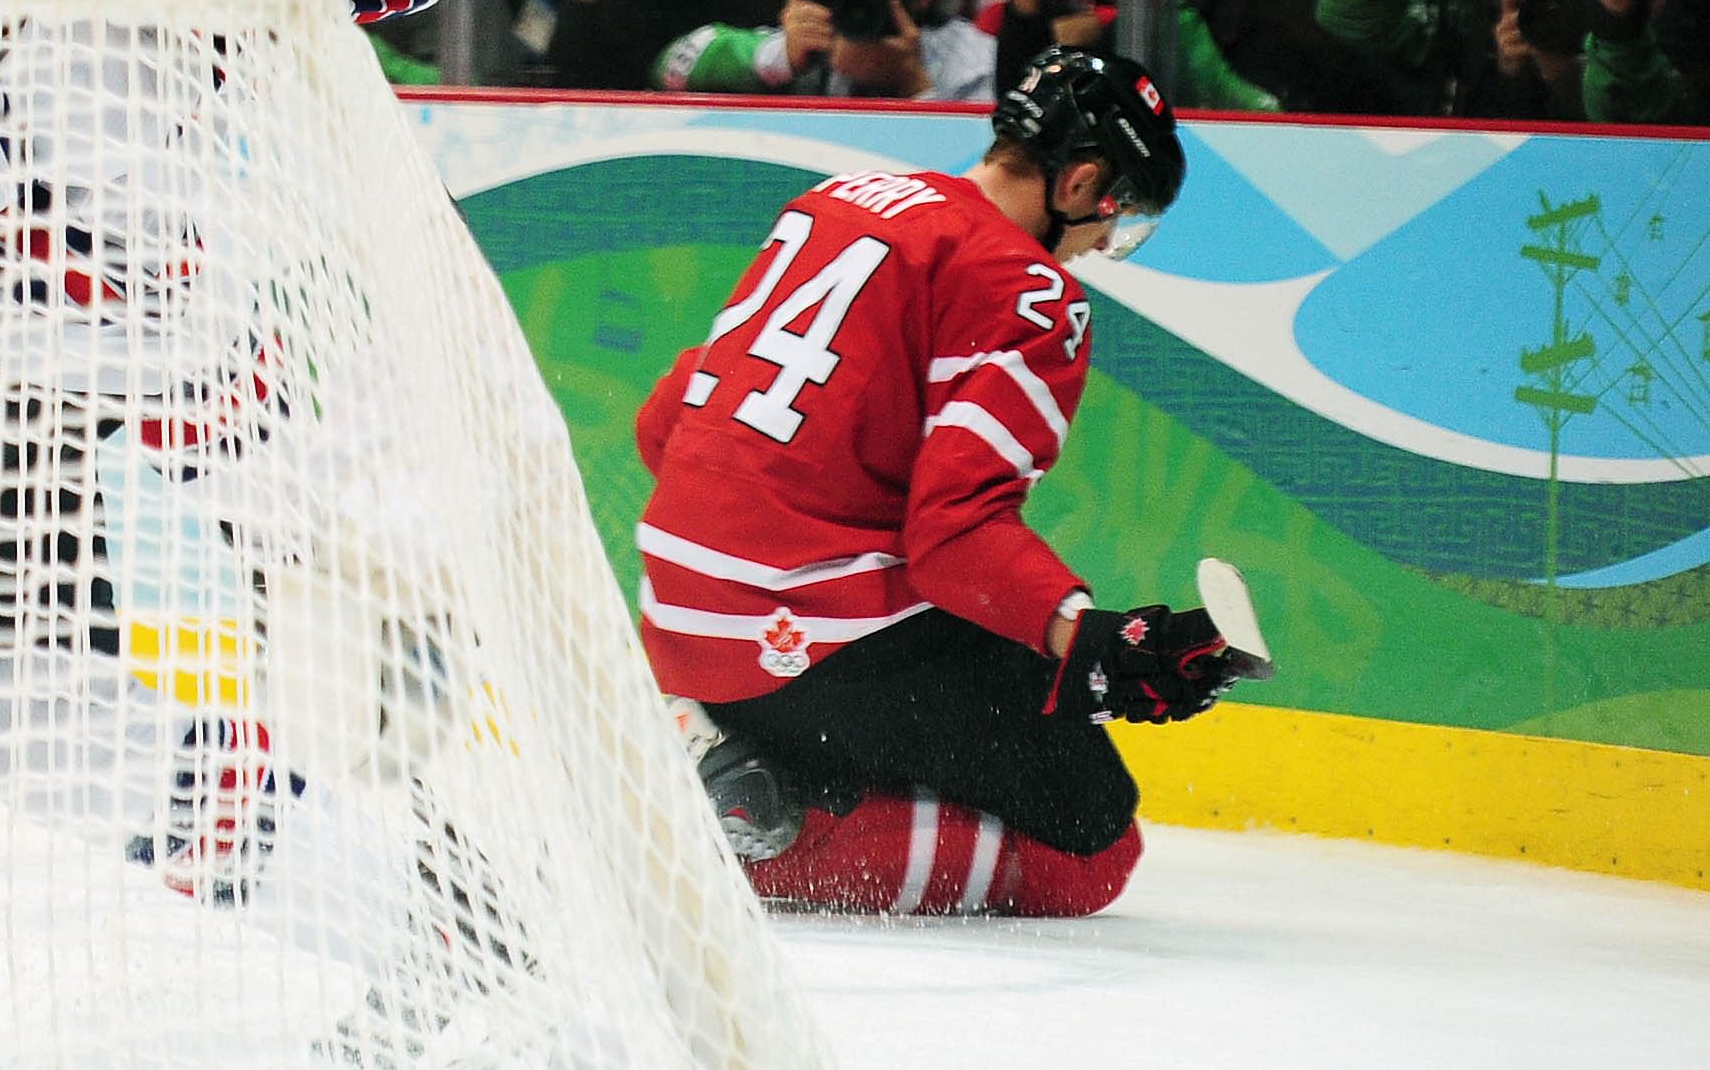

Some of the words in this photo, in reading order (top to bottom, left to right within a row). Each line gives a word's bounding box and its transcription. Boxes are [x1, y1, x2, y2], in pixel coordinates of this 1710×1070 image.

[810, 171, 947, 220] PERRY
[683, 209, 892, 445] 24
[1016, 261, 1092, 363] 24
